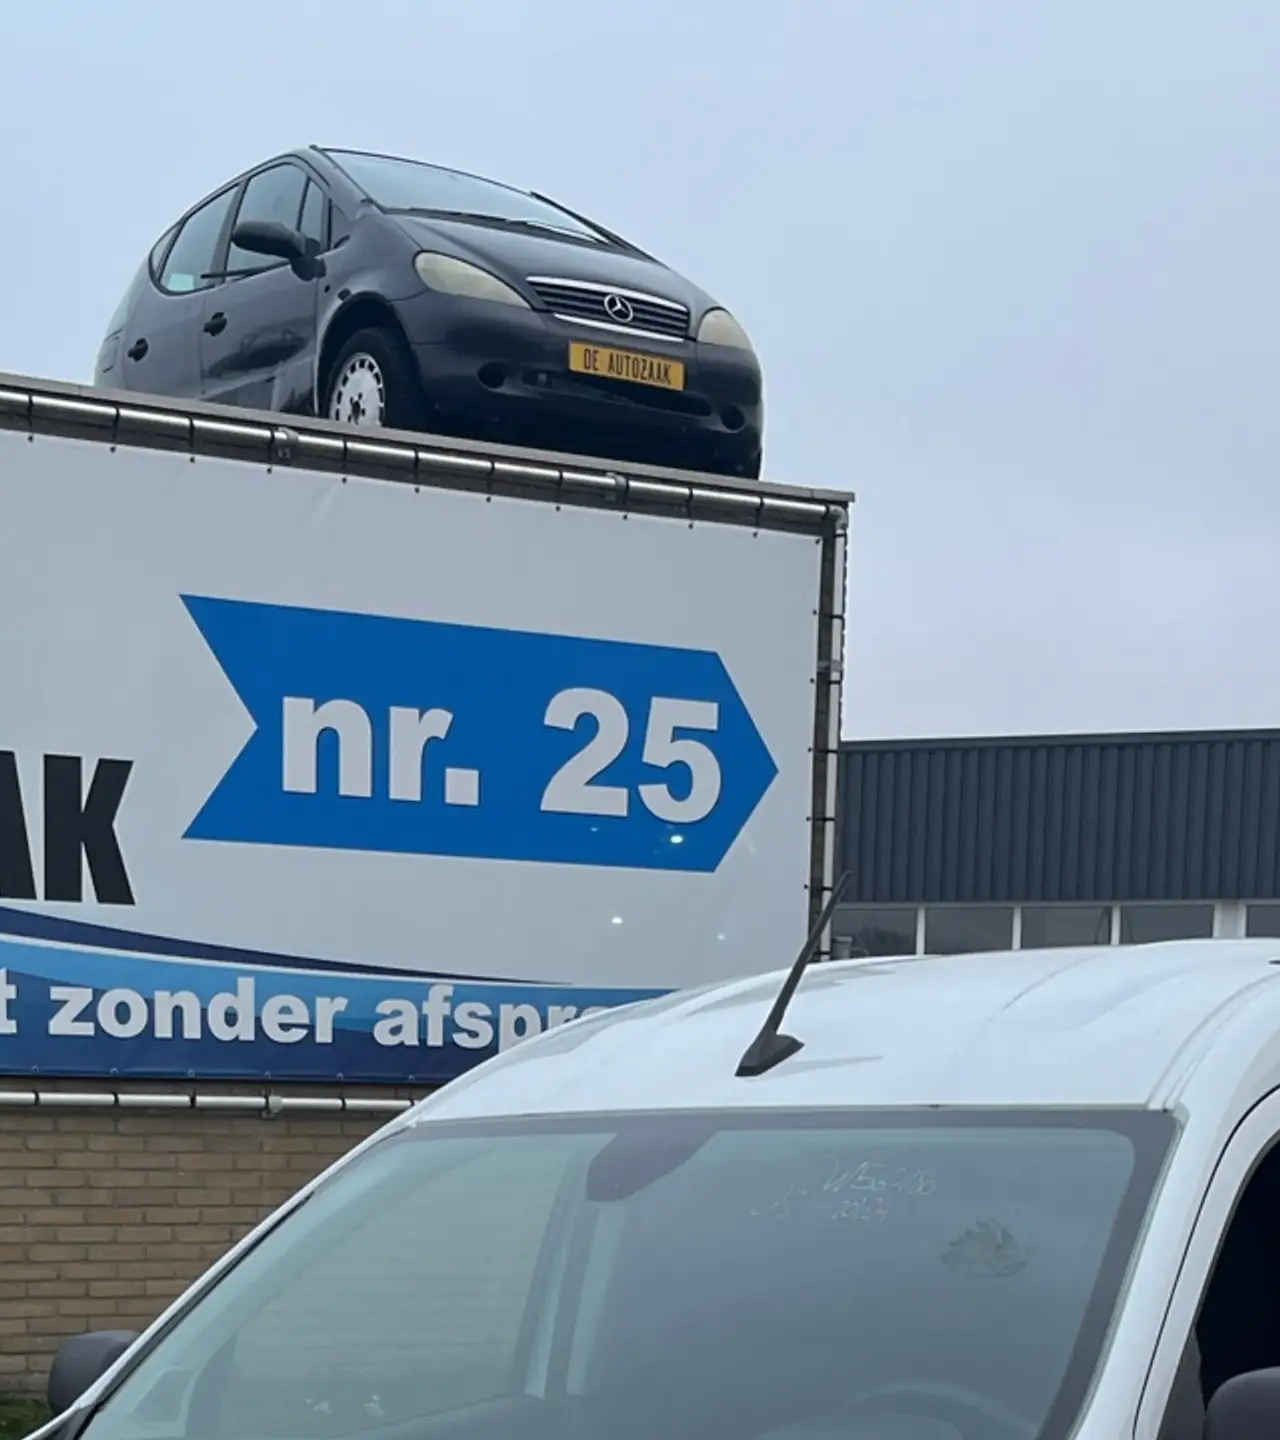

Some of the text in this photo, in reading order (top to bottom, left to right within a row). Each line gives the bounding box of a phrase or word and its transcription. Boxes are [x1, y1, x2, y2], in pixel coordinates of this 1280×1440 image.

[584, 347, 672, 385] DE AUTOZAAK
[281, 687, 722, 823] nr. 25
[47, 976, 349, 1044] zonder
[372, 983, 604, 1054] afspr
